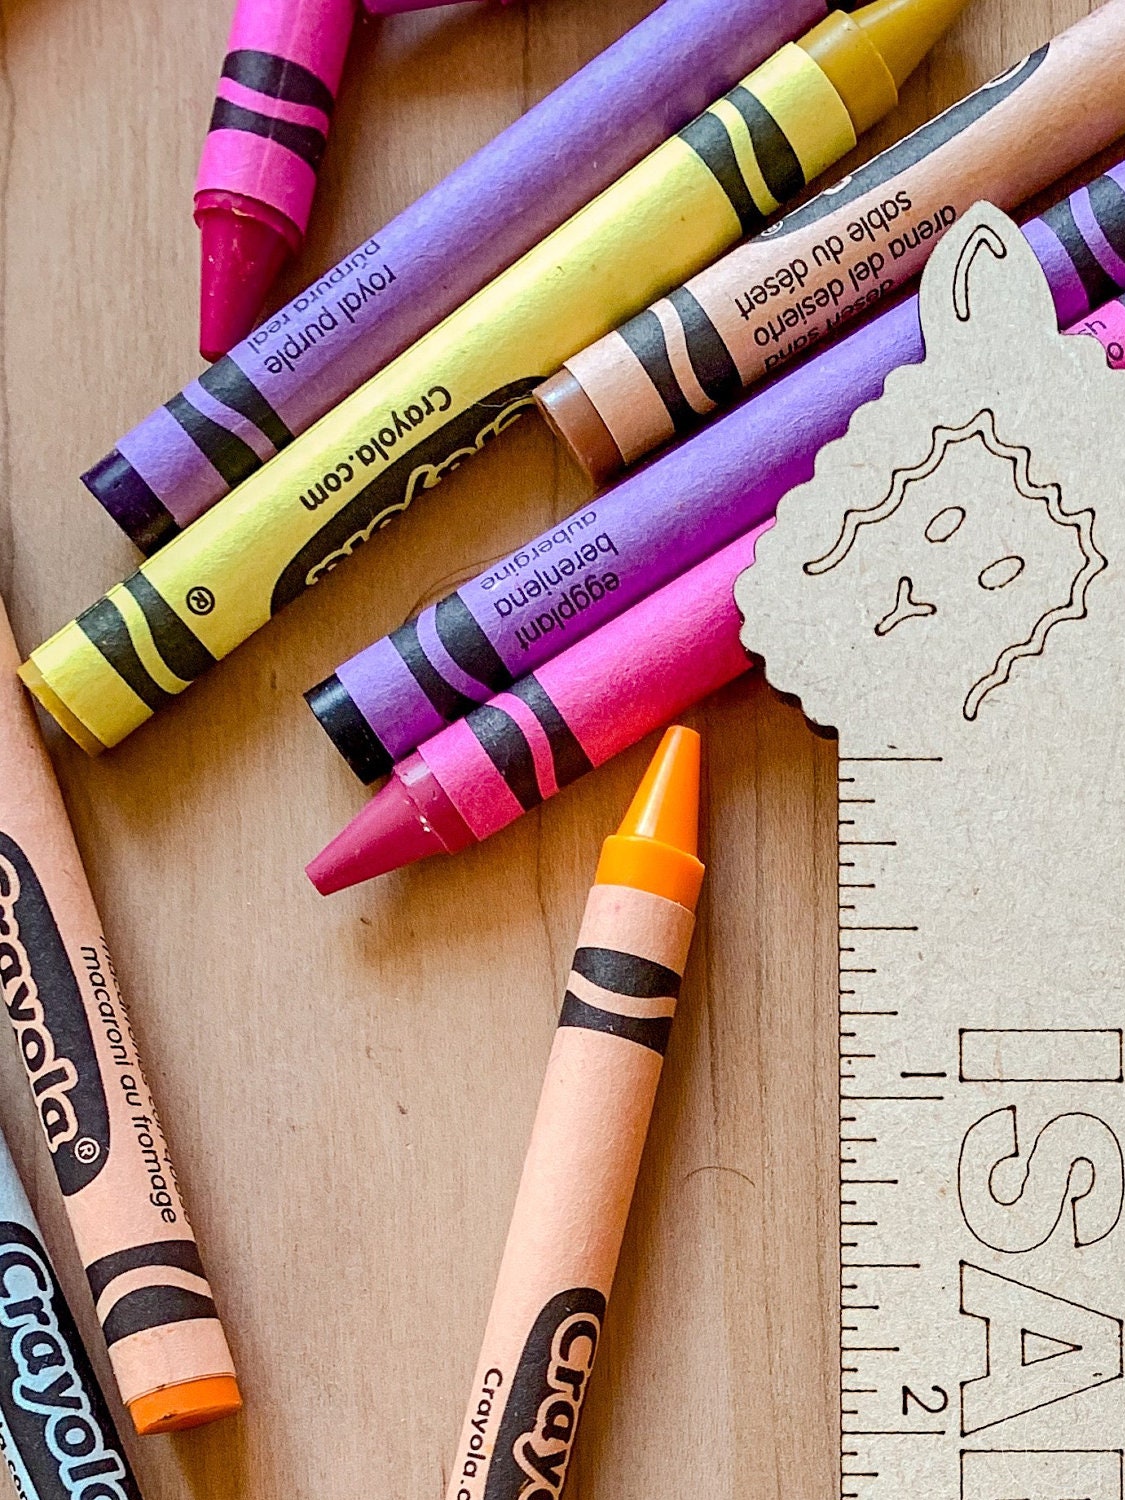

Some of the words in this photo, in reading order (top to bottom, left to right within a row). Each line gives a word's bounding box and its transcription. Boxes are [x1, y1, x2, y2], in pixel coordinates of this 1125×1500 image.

[846, 190, 912, 243] sable
[888, 204, 957, 260] arena
[812, 235, 844, 265] du
[849, 252, 885, 292] del
[337, 264, 397, 324] royal
[735, 258, 808, 320] désert
[753, 278, 844, 346] desierto
[247, 313, 291, 354] real
[263, 306, 339, 374] purple
[299, 385, 452, 511] Crayola.com
[480, 511, 597, 590] aubergine
[494, 533, 619, 618] berenjena
[515, 572, 620, 651] eggplant
[80, 946, 135, 1066] macaroni
[120, 1074, 142, 1107] au
[131, 1114, 177, 1224] fromage
[901, 1385, 948, 1416] 2
